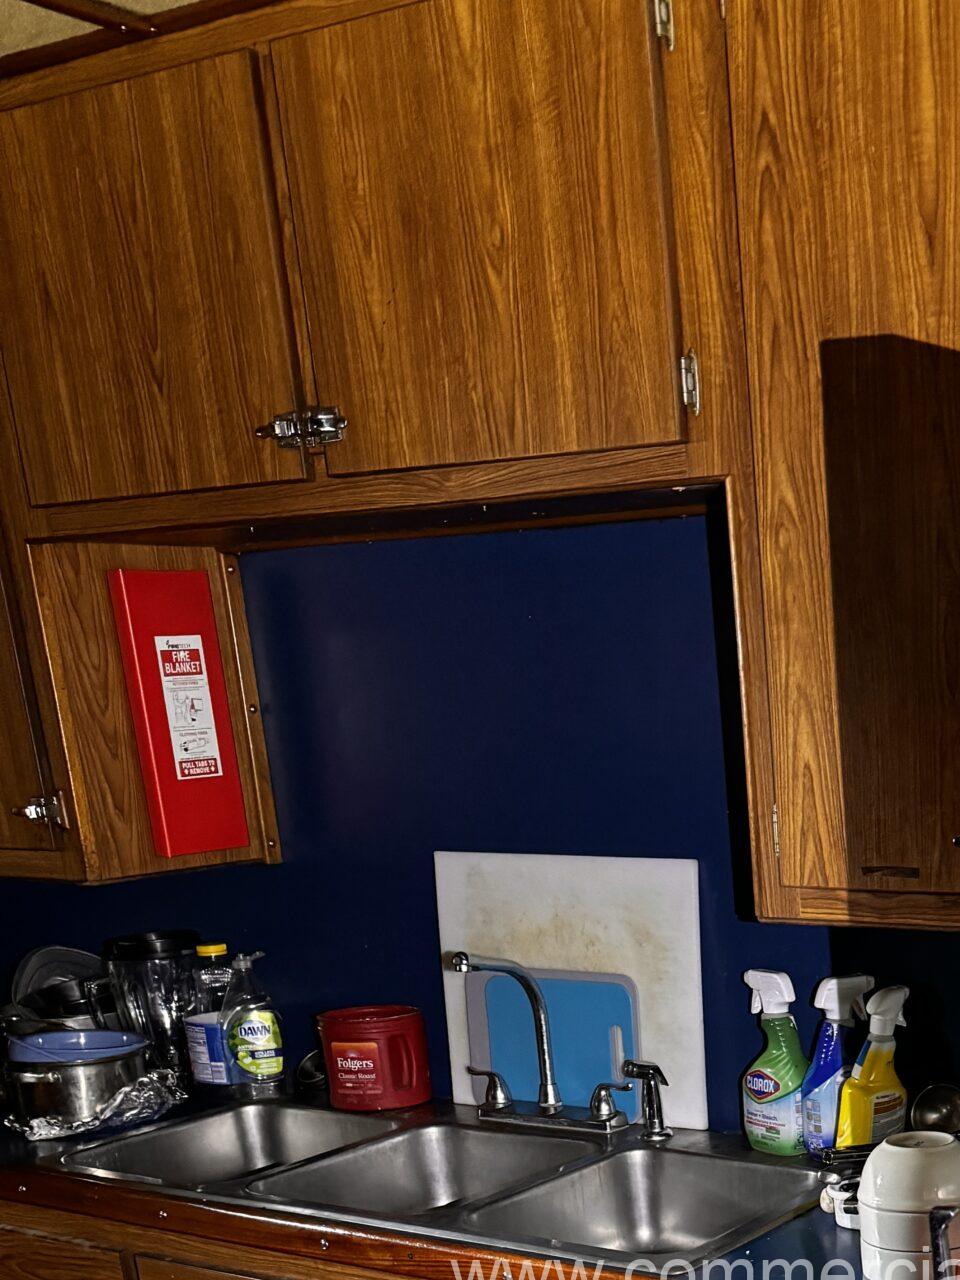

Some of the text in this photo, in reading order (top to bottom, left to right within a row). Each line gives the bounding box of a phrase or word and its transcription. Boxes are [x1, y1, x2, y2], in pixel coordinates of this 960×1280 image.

[171, 650, 190, 663] FIRE
[164, 661, 200, 674] BLANKET
[181, 761, 196, 769] PULL
[189, 766, 211, 774] REMOVE
[239, 1025, 271, 1037] DAWN
[337, 1057, 374, 1071] Folgers
[746, 1075, 775, 1093] CLOROX
